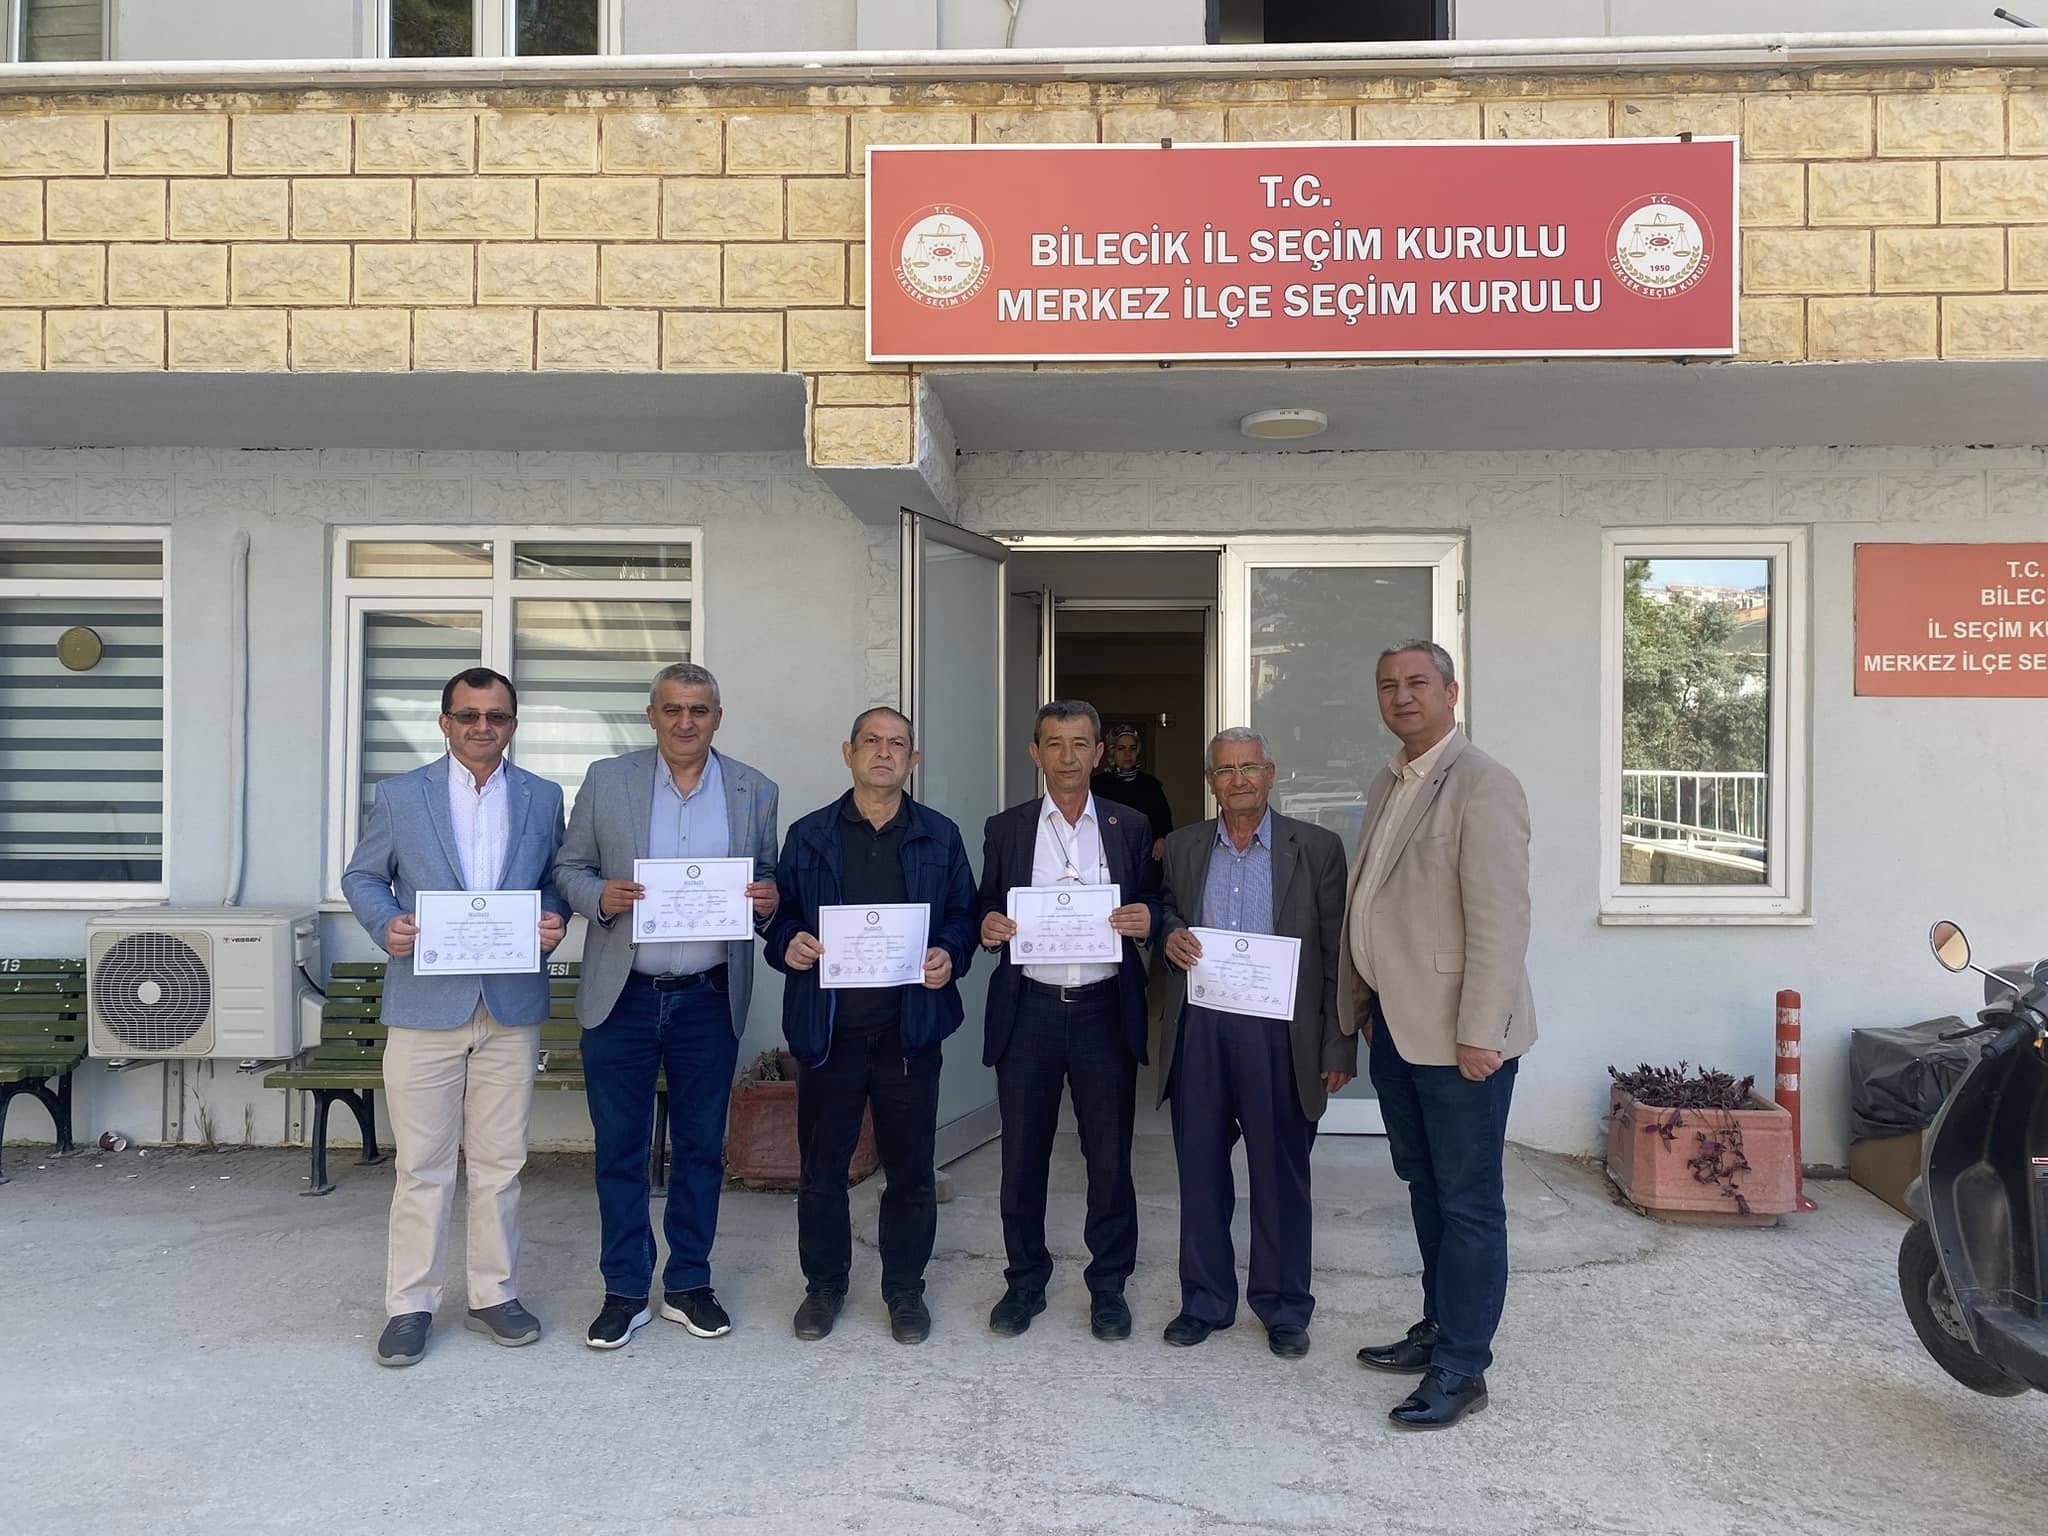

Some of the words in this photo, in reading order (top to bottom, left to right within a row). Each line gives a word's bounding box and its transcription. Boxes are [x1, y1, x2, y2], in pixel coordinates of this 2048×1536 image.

[1258, 174, 1332, 208] T.C.
[1650, 196, 1671, 204] T.C.
[934, 206, 953, 214] T.C.
[1030, 224, 1189, 266] BİLECİK
[1203, 223, 1239, 264] İL
[1248, 221, 1382, 271] SEÇİM
[1396, 224, 1568, 261] KURULU
[895, 265, 924, 301] YÜKSEK
[926, 296, 959, 308] SEÇİM
[961, 265, 991, 302] KURULU
[1610, 255, 1640, 291] YÜKSEK
[1642, 287, 1677, 299] SEÇİM
[1680, 254, 1711, 291] KURULU
[997, 286, 1171, 321] MERKEZ
[1182, 278, 1273, 328] İLÇE
[1283, 275, 1417, 325] SEÇİM
[1431, 279, 1602, 315] KURULU
[2006, 561, 2045, 578] T.C.
[1928, 618, 1948, 639] İL
[1953, 617, 2022, 642] SEÇİM
[1864, 654, 1956, 671] MERKEZ
[1963, 650, 2012, 675] İLÇE
